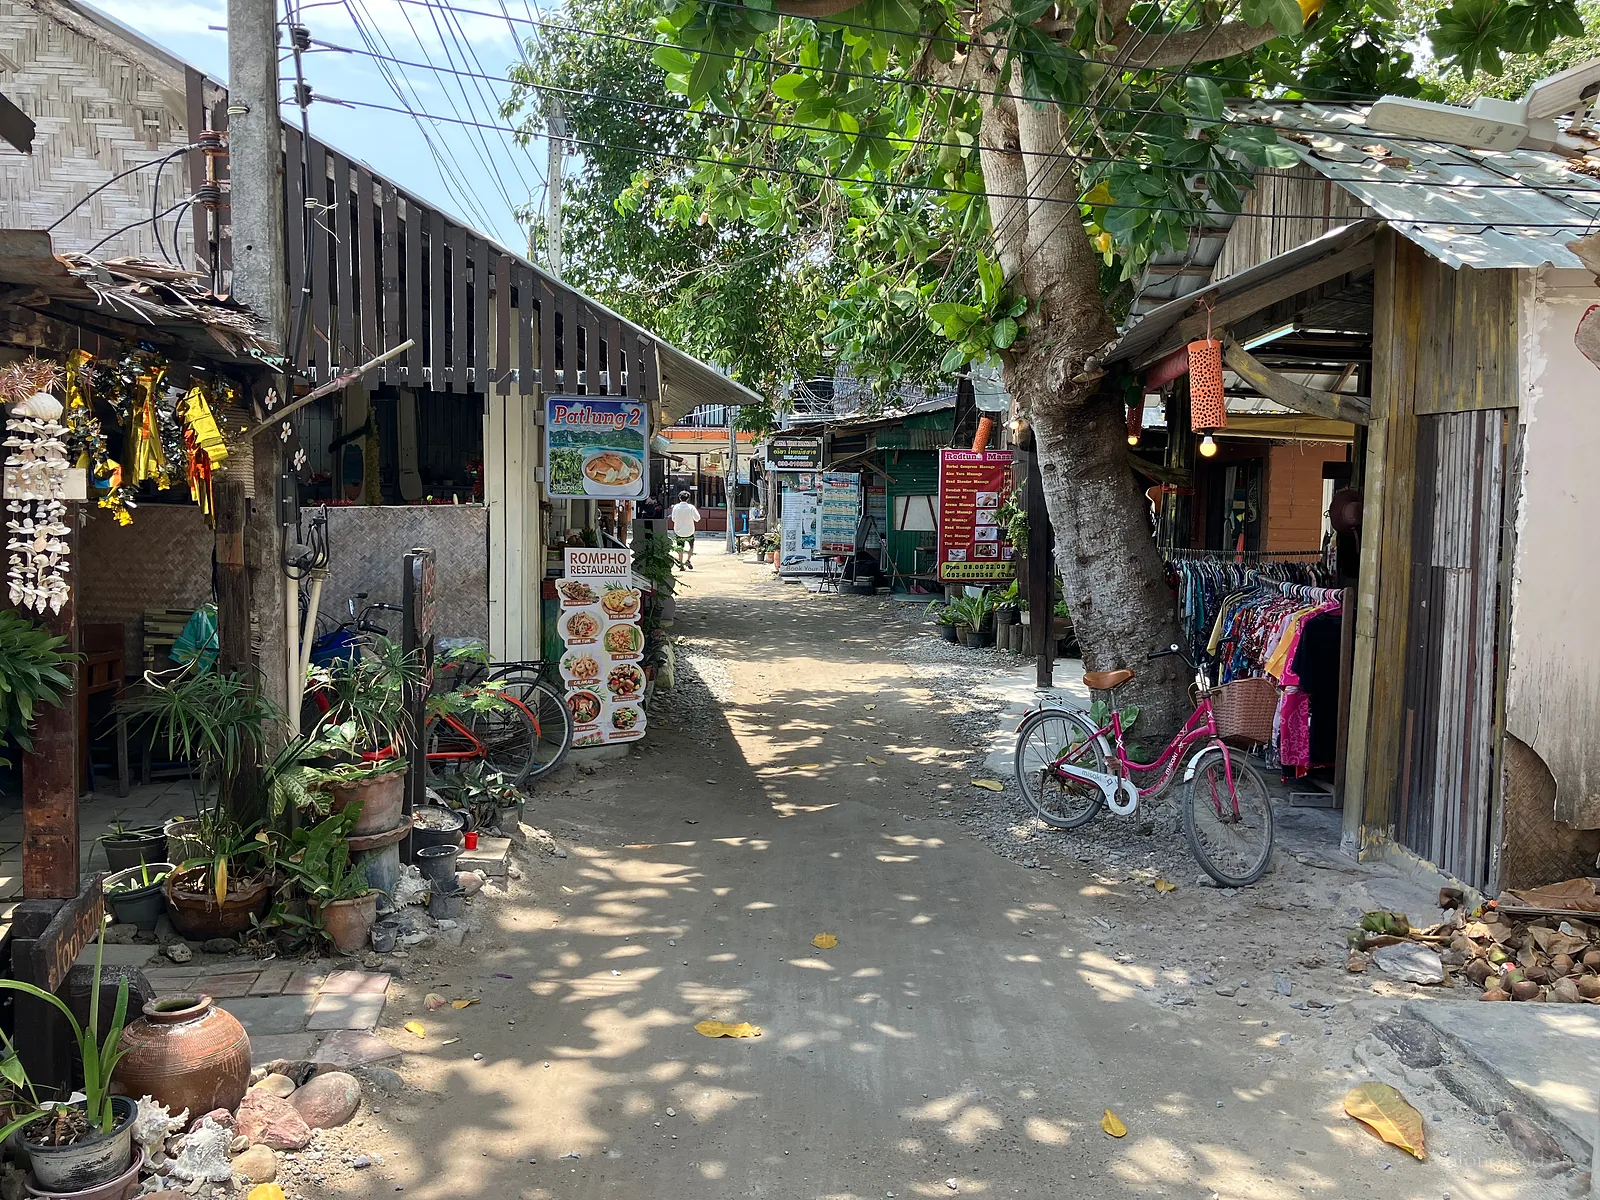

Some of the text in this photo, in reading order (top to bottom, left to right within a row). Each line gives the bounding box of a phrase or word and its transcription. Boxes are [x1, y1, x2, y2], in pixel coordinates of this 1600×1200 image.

[554, 405, 640, 430] Patlung 2
[570, 552, 627, 564] ROMPHO
[570, 566, 627, 574] RESTAURANT
[1165, 752, 1178, 775] misaki
[1081, 770, 1102, 781] misaki
